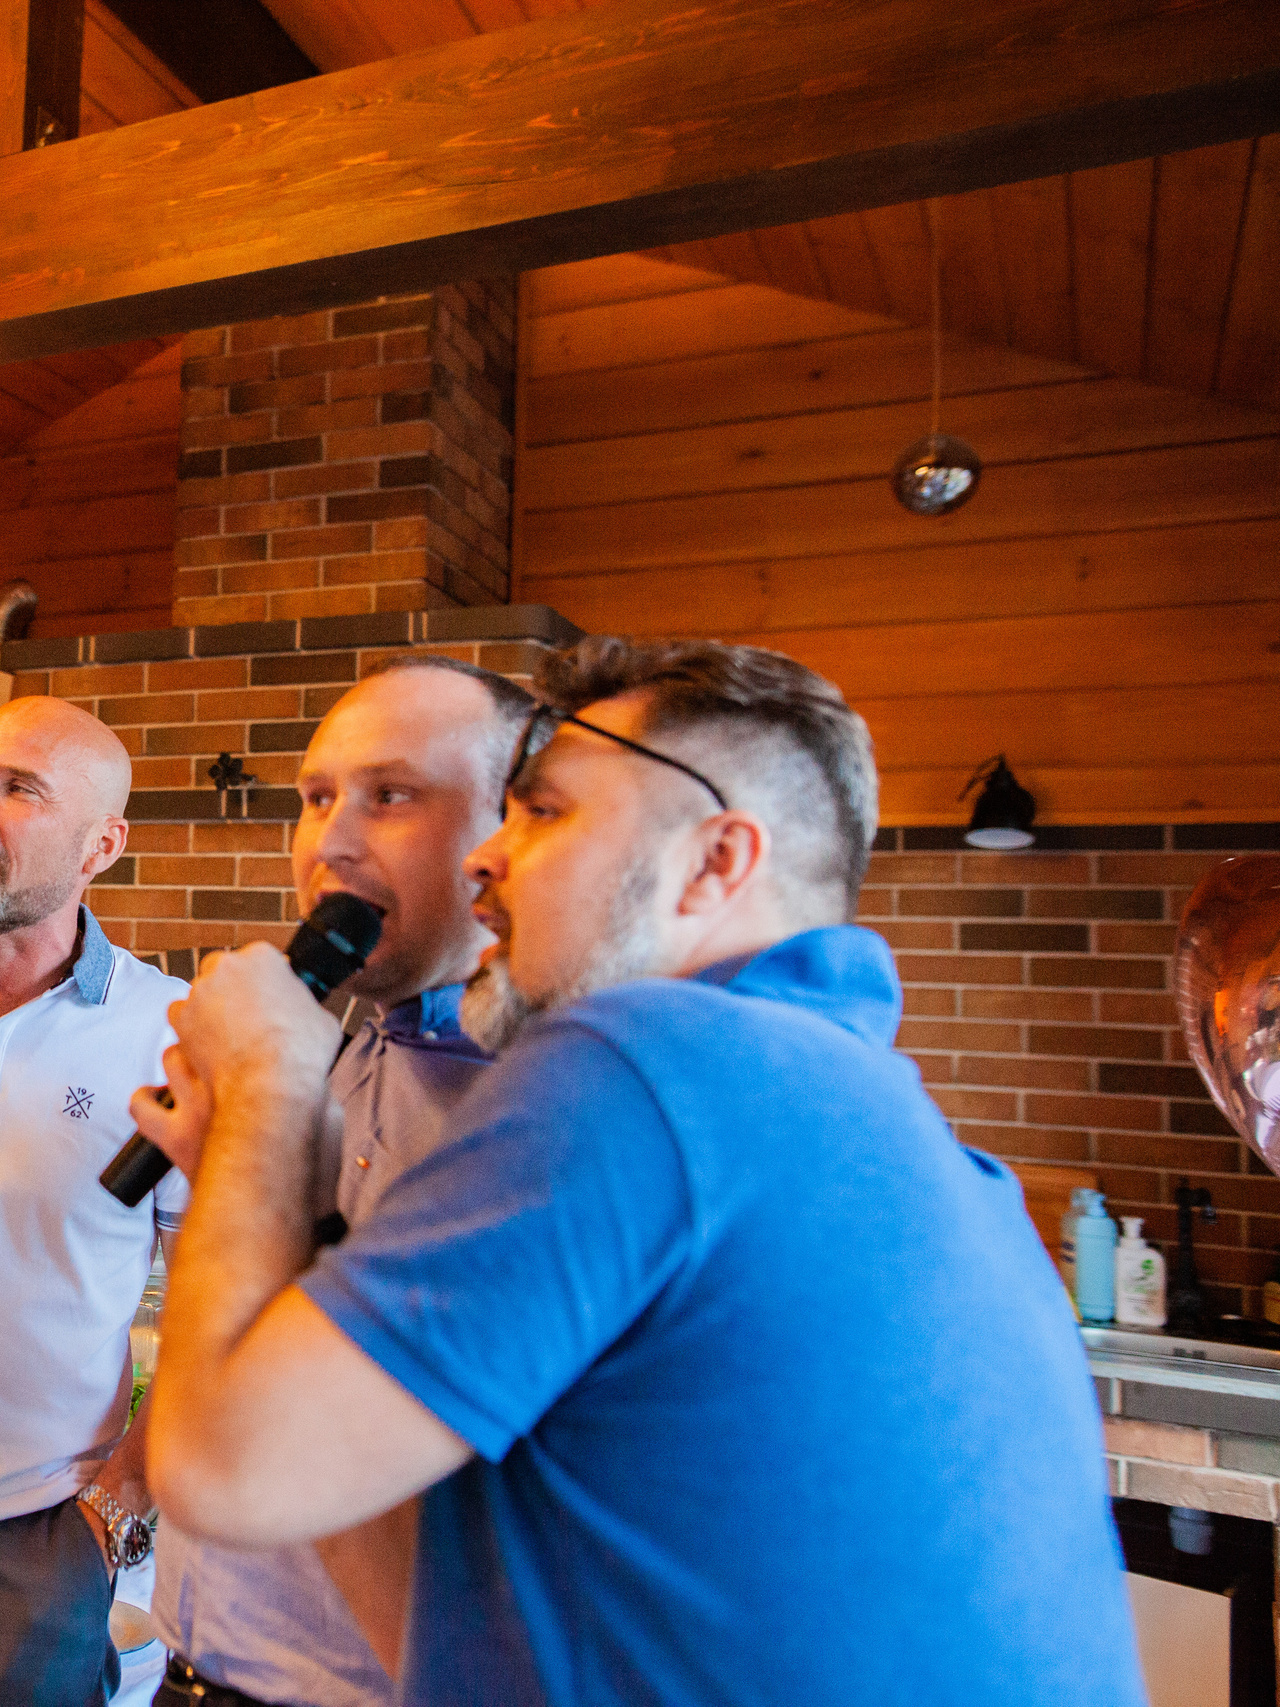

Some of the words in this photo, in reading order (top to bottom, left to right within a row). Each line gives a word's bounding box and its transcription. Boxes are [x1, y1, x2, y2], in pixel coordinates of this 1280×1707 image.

[77, 1087, 87, 1096] 19
[65, 1094, 72, 1104] T
[87, 1100, 94, 1110] T
[70, 1110, 82, 1119] 62
